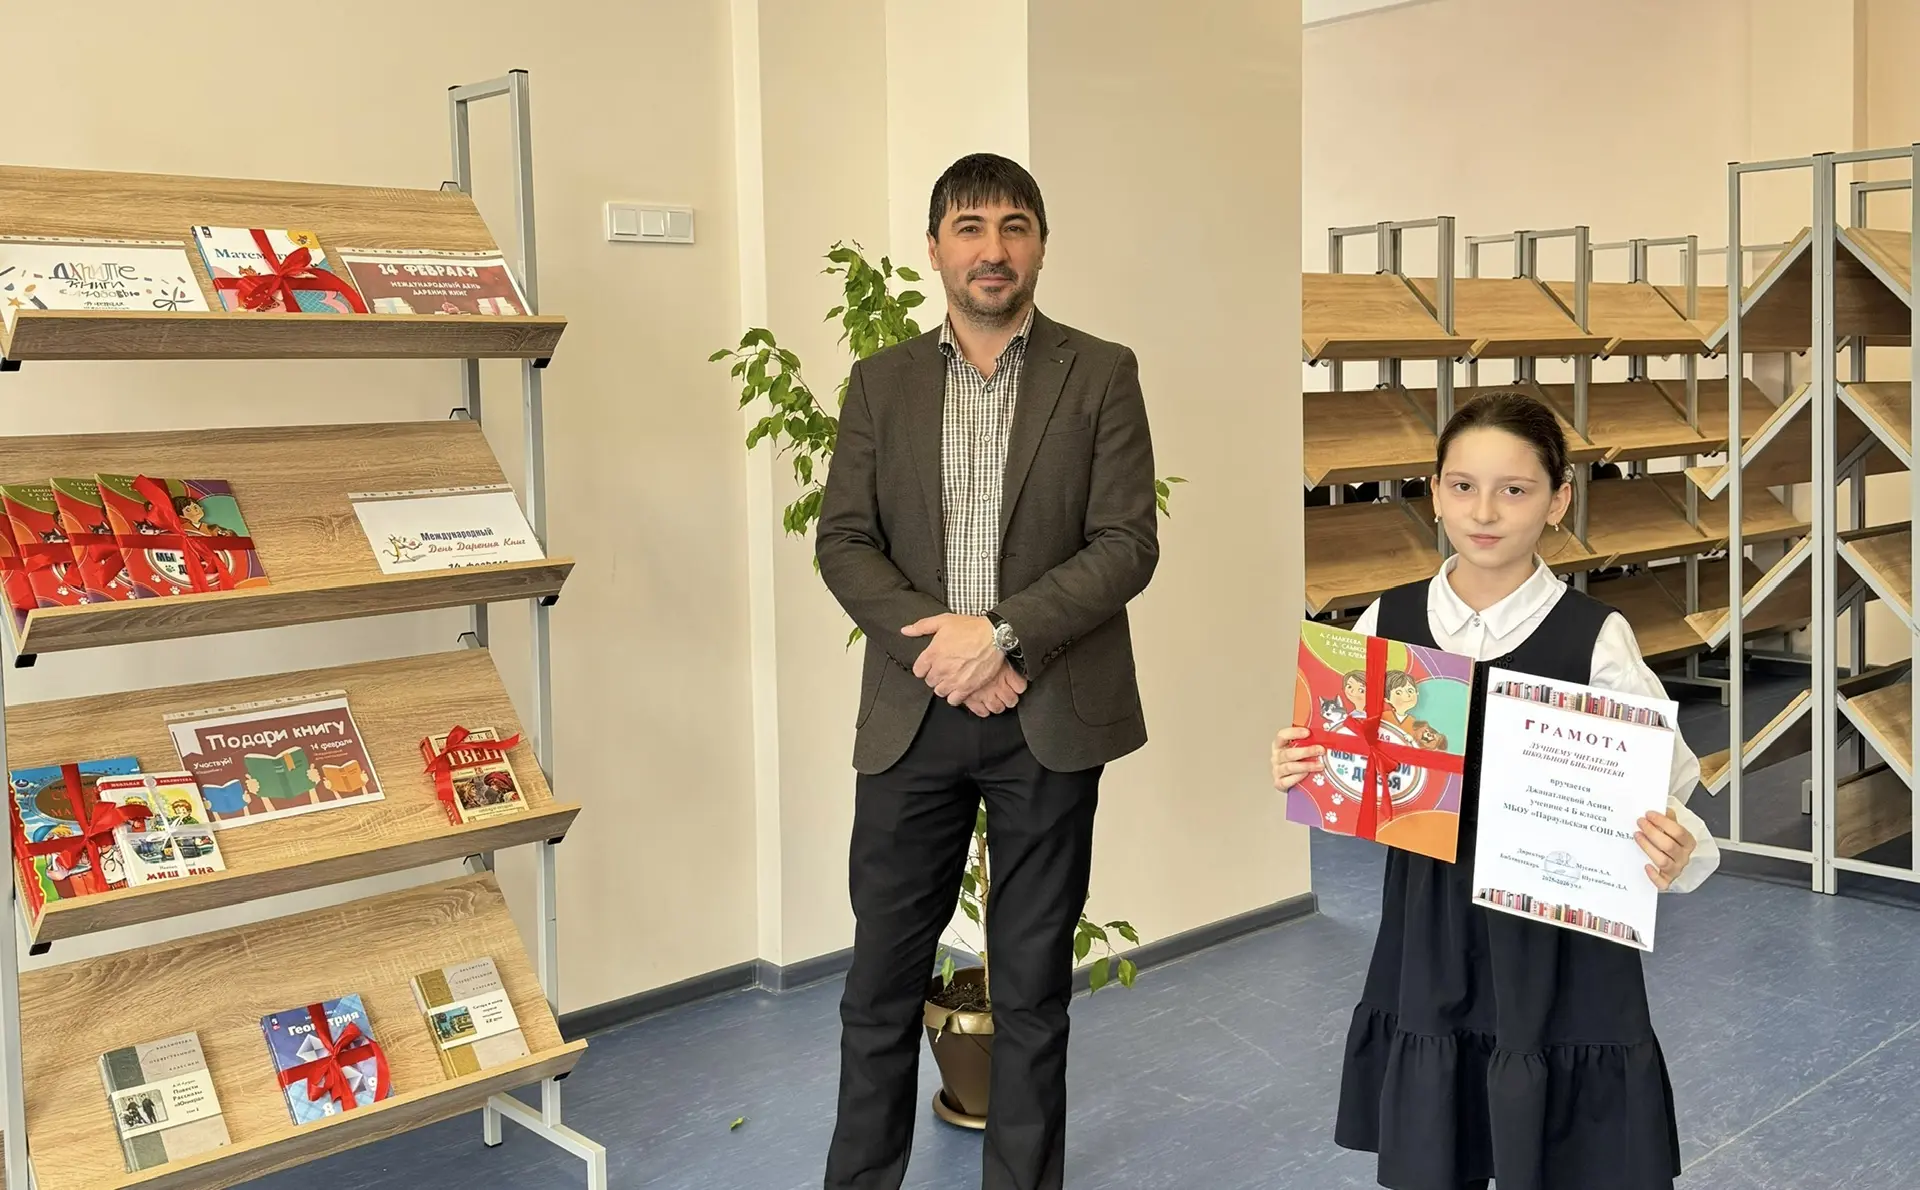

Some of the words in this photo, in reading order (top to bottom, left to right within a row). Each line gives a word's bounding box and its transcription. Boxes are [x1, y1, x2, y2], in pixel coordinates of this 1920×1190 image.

[378, 263, 399, 275] 14
[403, 264, 479, 278] ФЕВРАЛЯ
[390, 281, 461, 289] МЕЖДУНАРОДНЫЙ
[448, 289, 468, 297] КНИГ
[420, 527, 494, 541] Международный
[428, 543, 453, 554] День
[456, 541, 500, 552] Дарения
[503, 537, 526, 546] Книг
[155, 552, 177, 562] МЫ
[1341, 643, 1366, 653] САМКО
[1348, 651, 1366, 660] КЛЕМ
[205, 729, 288, 751] Подари
[292, 720, 345, 738] книгу
[1525, 718, 1627, 752] ГРАМОТА
[310, 743, 318, 751] 14
[320, 738, 353, 750] февраля
[1331, 750, 1353, 762] МЫ
[1529, 742, 1573, 757] ЛУЧШЕМУ
[1574, 751, 1619, 768] ЧИТАТЕЛЮ
[193, 756, 233, 770] Участвуй!
[1522, 749, 1569, 765] ШКОЛЬНОЙ
[1569, 760, 1625, 778] БИБЛИОТЕКИ
[1549, 778, 1591, 793] вручается
[1529, 799, 1563, 812] ученице
[1571, 807, 1578, 815] Б
[1579, 812, 1607, 822] класса
[1503, 802, 1529, 815] МБОУ
[1589, 824, 1614, 836] СОШ
[1517, 847, 1546, 860] Директор
[288, 1011, 360, 1036] Геотрия
[323, 1102, 335, 1116] 8
